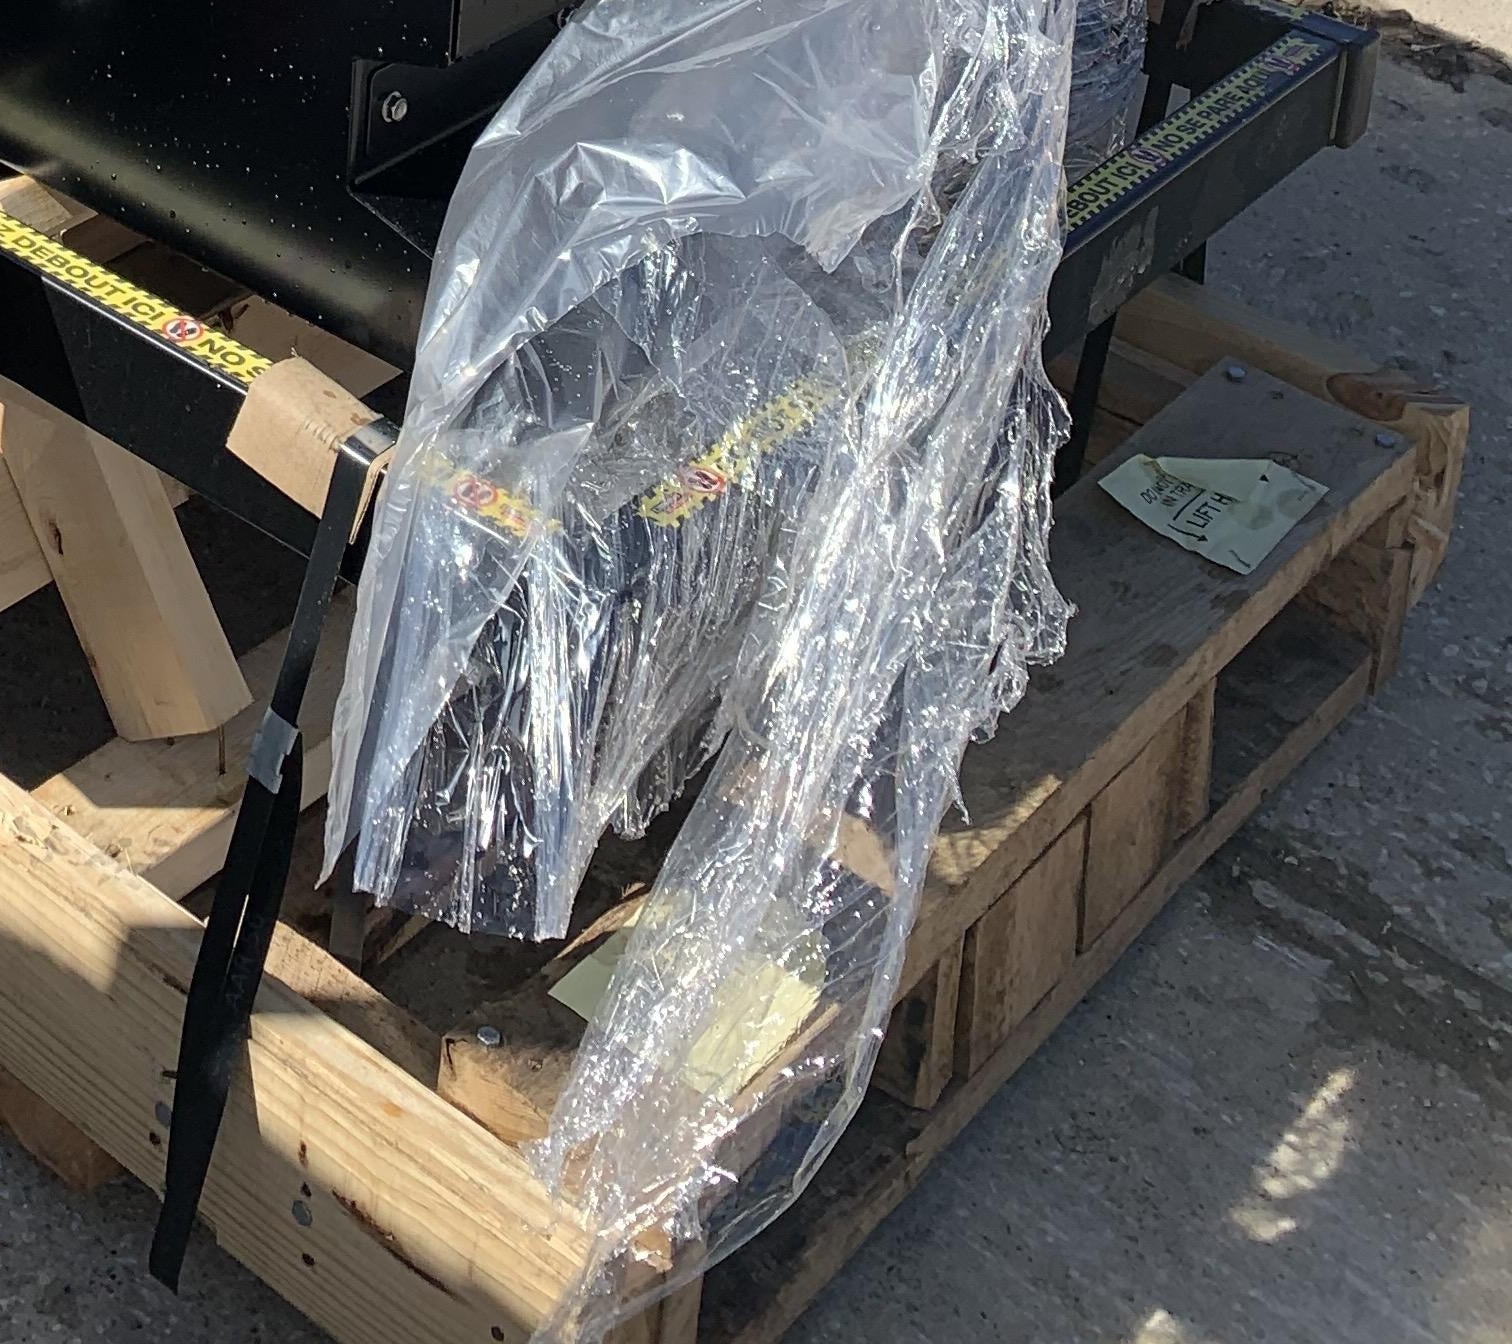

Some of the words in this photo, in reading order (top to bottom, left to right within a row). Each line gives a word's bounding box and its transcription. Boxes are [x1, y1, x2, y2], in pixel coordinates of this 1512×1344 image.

[1152, 132, 1186, 153] NO
[1176, 113, 1204, 137] SE
[1111, 161, 1143, 181] ICI
[12, 235, 126, 298] DEBOUT
[124, 296, 166, 322] ICI
[197, 338, 246, 366] NO
[1186, 500, 1222, 529] LIFT
